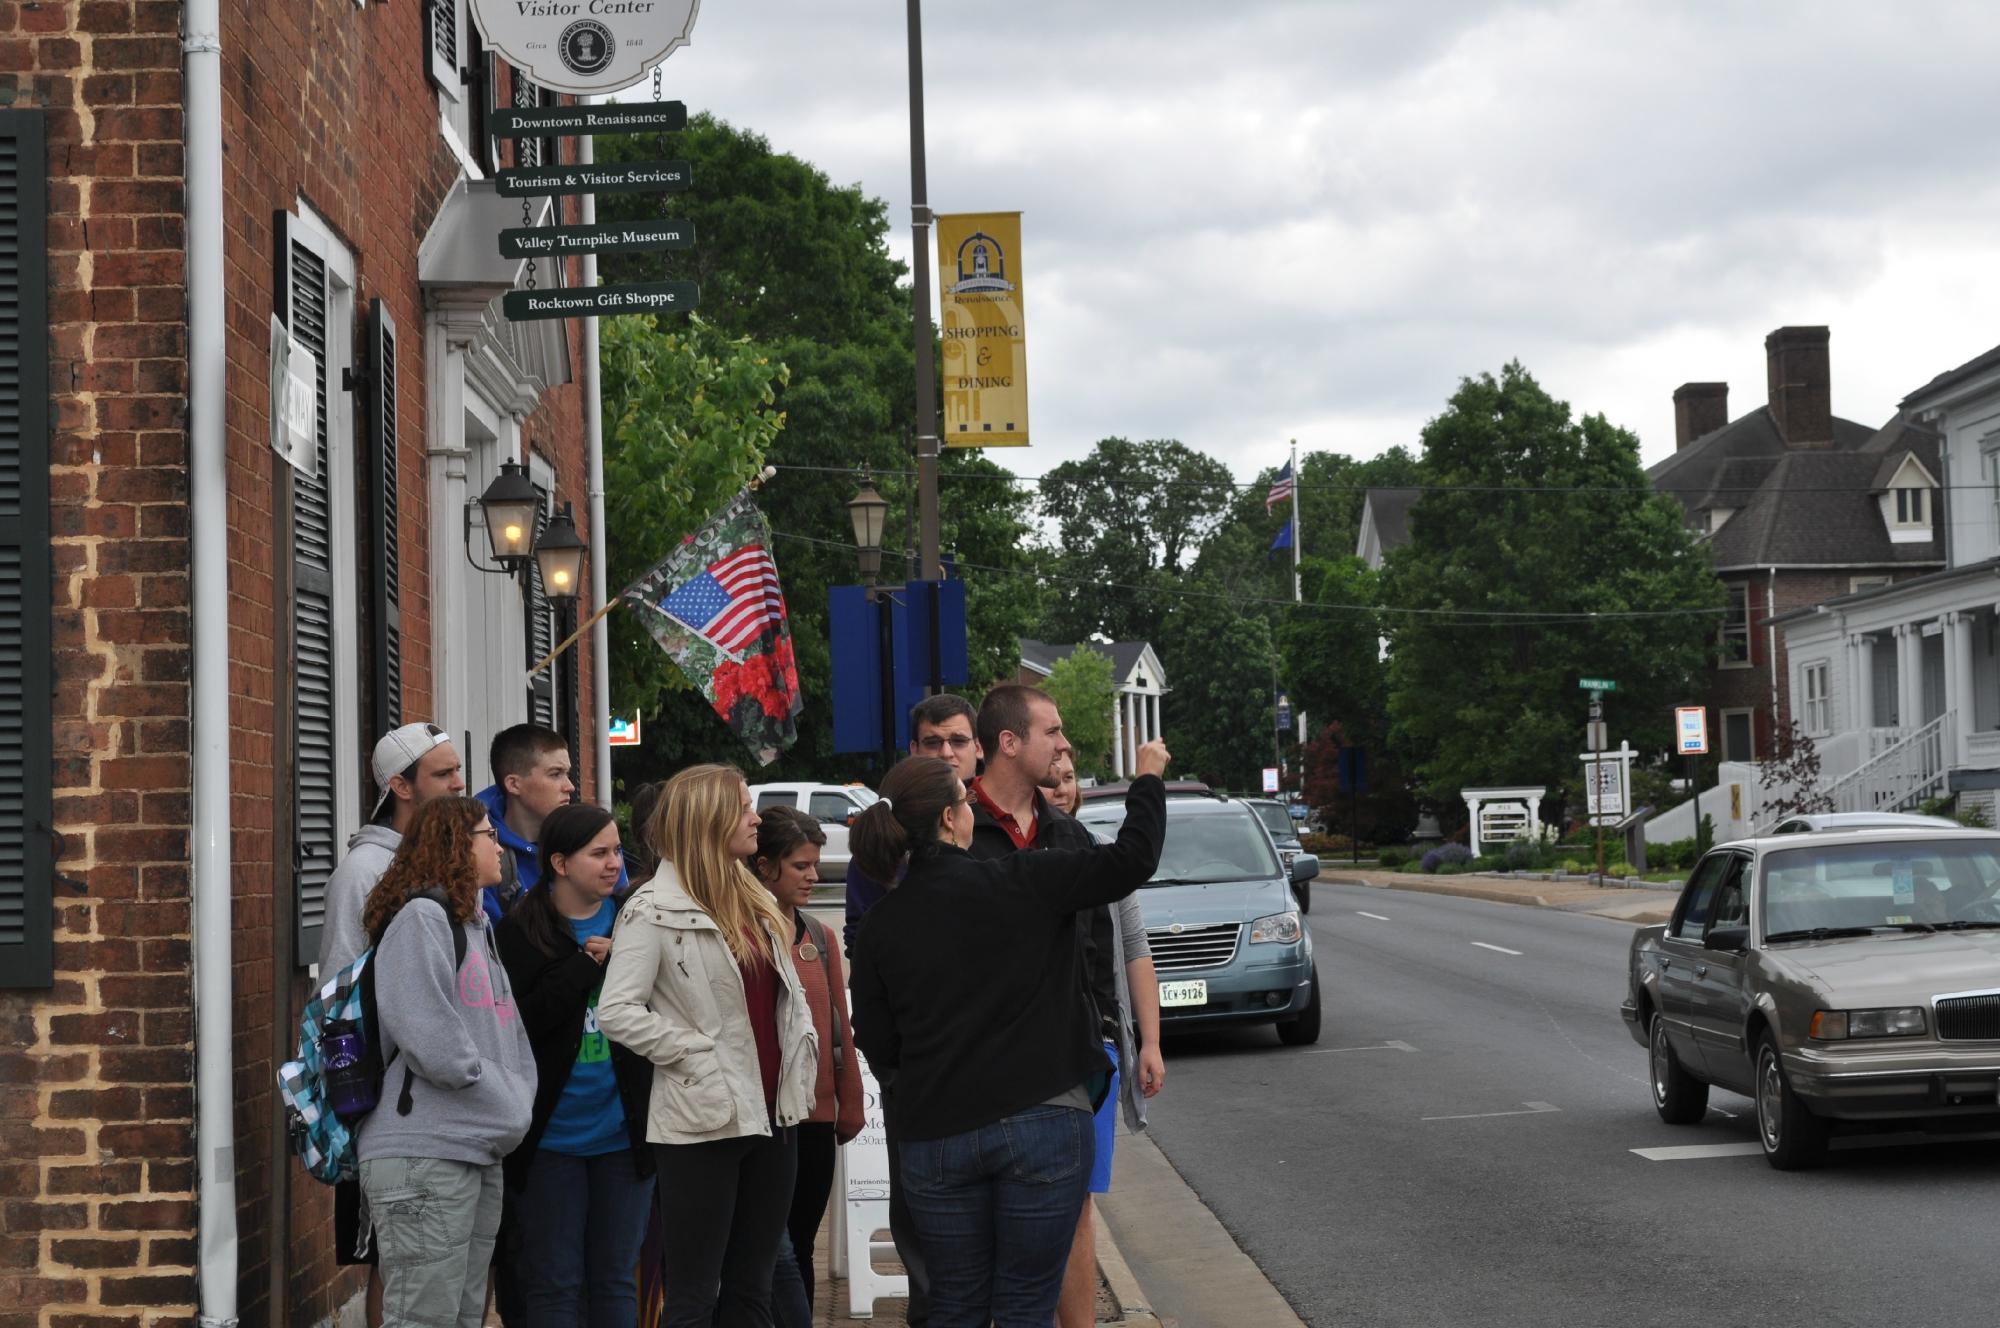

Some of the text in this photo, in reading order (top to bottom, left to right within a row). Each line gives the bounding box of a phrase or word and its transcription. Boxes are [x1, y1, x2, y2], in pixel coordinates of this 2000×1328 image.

[517, 0, 654, 16] Visitor Center
[512, 112, 667, 129] Downtown Renaissance
[506, 170, 681, 188] Tourism & Visitor Services
[515, 231, 680, 250] Valley Turnpike Museum
[528, 291, 675, 310] Rocktown Gift Shoppe
[947, 325, 1018, 340] SHOPPING
[976, 347, 992, 366] &
[958, 376, 1011, 389] DINING
[294, 381, 311, 434] WAY
